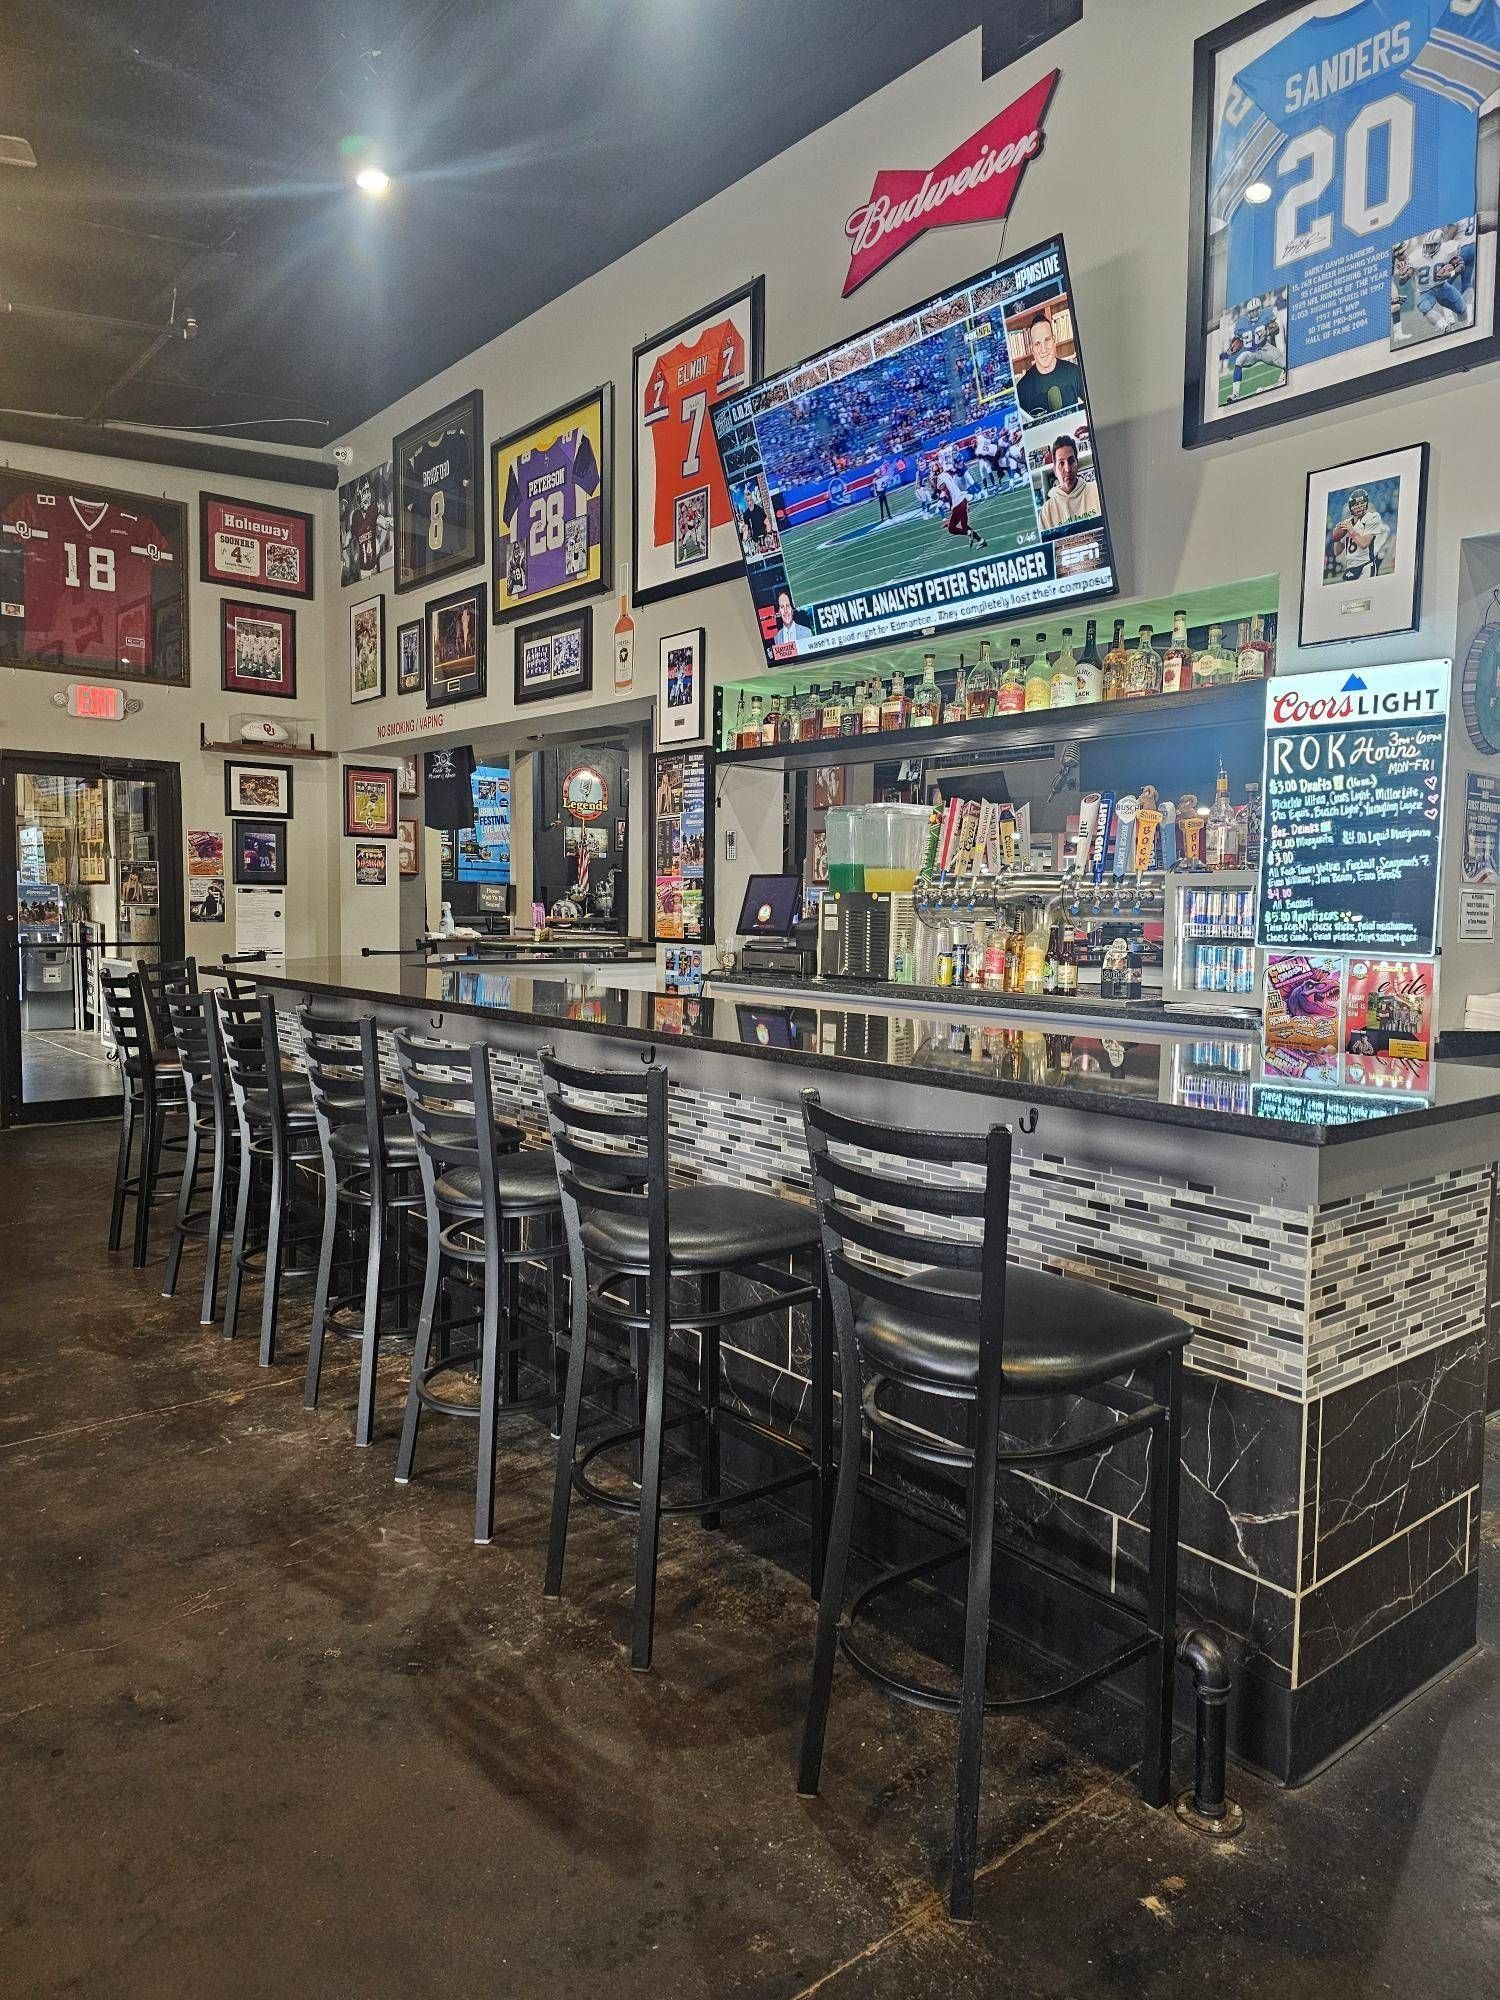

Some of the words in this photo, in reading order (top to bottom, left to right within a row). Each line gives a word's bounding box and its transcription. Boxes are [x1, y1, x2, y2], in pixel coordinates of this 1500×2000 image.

[1285, 21, 1411, 114] SANDERS
[846, 129, 1039, 255] Budweiser
[1273, 92, 1416, 271] 20
[1015, 253, 1060, 291] #PMSLIVE
[1304, 264, 1324, 278] BARRY
[1325, 257, 1345, 270] DAVID
[1345, 245, 1376, 262] SANDERS
[1313, 270, 1337, 284] CAREER
[1338, 259, 1366, 274] RUSHING
[1366, 250, 1390, 264] YARDS
[1307, 296, 1319, 307] NFL
[1320, 287, 1343, 301] ROOKIE
[1344, 283, 1354, 292] OF
[1356, 277, 1369, 289] THE
[1370, 270, 1389, 284] YEAR
[1309, 282, 1333, 296] CAREER
[1333, 271, 1362, 286] RUSHING
[1310, 300, 1337, 314] RUSHING
[1338, 292, 1360, 305] YARDS
[1360, 287, 1368, 297] IN
[1332, 308, 1344, 318] NFL
[1345, 300, 1360, 312] MVP
[1333, 308, 1367, 327] PRO-BOWL
[1305, 335, 1321, 346] HALL
[1322, 331, 1331, 340] OF
[1332, 325, 1351, 338] FAME
[677, 353, 709, 387] ELWAY
[721, 346, 734, 378] 7
[653, 379, 664, 409] 7
[680, 388, 707, 479] 7
[528, 466, 565, 498] PETERSON
[428, 490, 445, 550] 8
[529, 490, 565, 557] 28
[220, 535, 255, 549] SOONERS
[230, 546, 242, 563] 4
[1060, 541, 1100, 567] ESPN
[64, 542, 116, 592] 18
[816, 602, 849, 629] ESPN
[848, 596, 873, 622] NFL
[872, 581, 926, 617] ANALYST
[925, 569, 969, 603] PETER
[969, 551, 1048, 592] SCHRAGER
[937, 609, 959, 622] They
[960, 595, 1010, 615] completely
[77, 686, 116, 718] EXIT
[1273, 690, 1354, 724] Coors
[1358, 688, 1440, 716] LIGHT
[377, 725, 386, 739] NO
[385, 719, 415, 737] SMOKING
[420, 713, 444, 730] VAPING
[1350, 736, 1422, 765] Hours
[1269, 778, 1298, 795] $3.00
[1299, 777, 1332, 793] Drafts
[562, 797, 609, 815] Legends
[1097, 802, 1109, 835] LIGHT
[1116, 803, 1143, 811] BUSCH
[1270, 809, 1287, 822] Dos
[1313, 805, 1340, 819] Busch
[479, 815, 510, 826] FESTIVAL
[1291, 822, 1320, 836] Drinks
[1093, 835, 1104, 861] BUD
[1121, 825, 1129, 847] BUSCH
[1138, 826, 1152, 866] BOCK
[259, 856, 270, 867] 20
[1117, 846, 1128, 868] LIGHT
[1268, 867, 1280, 878] All
[1314, 873, 1331, 885] Jim
[1272, 899, 1283, 910] All
[1348, 993, 1366, 1001] FRIDAY
